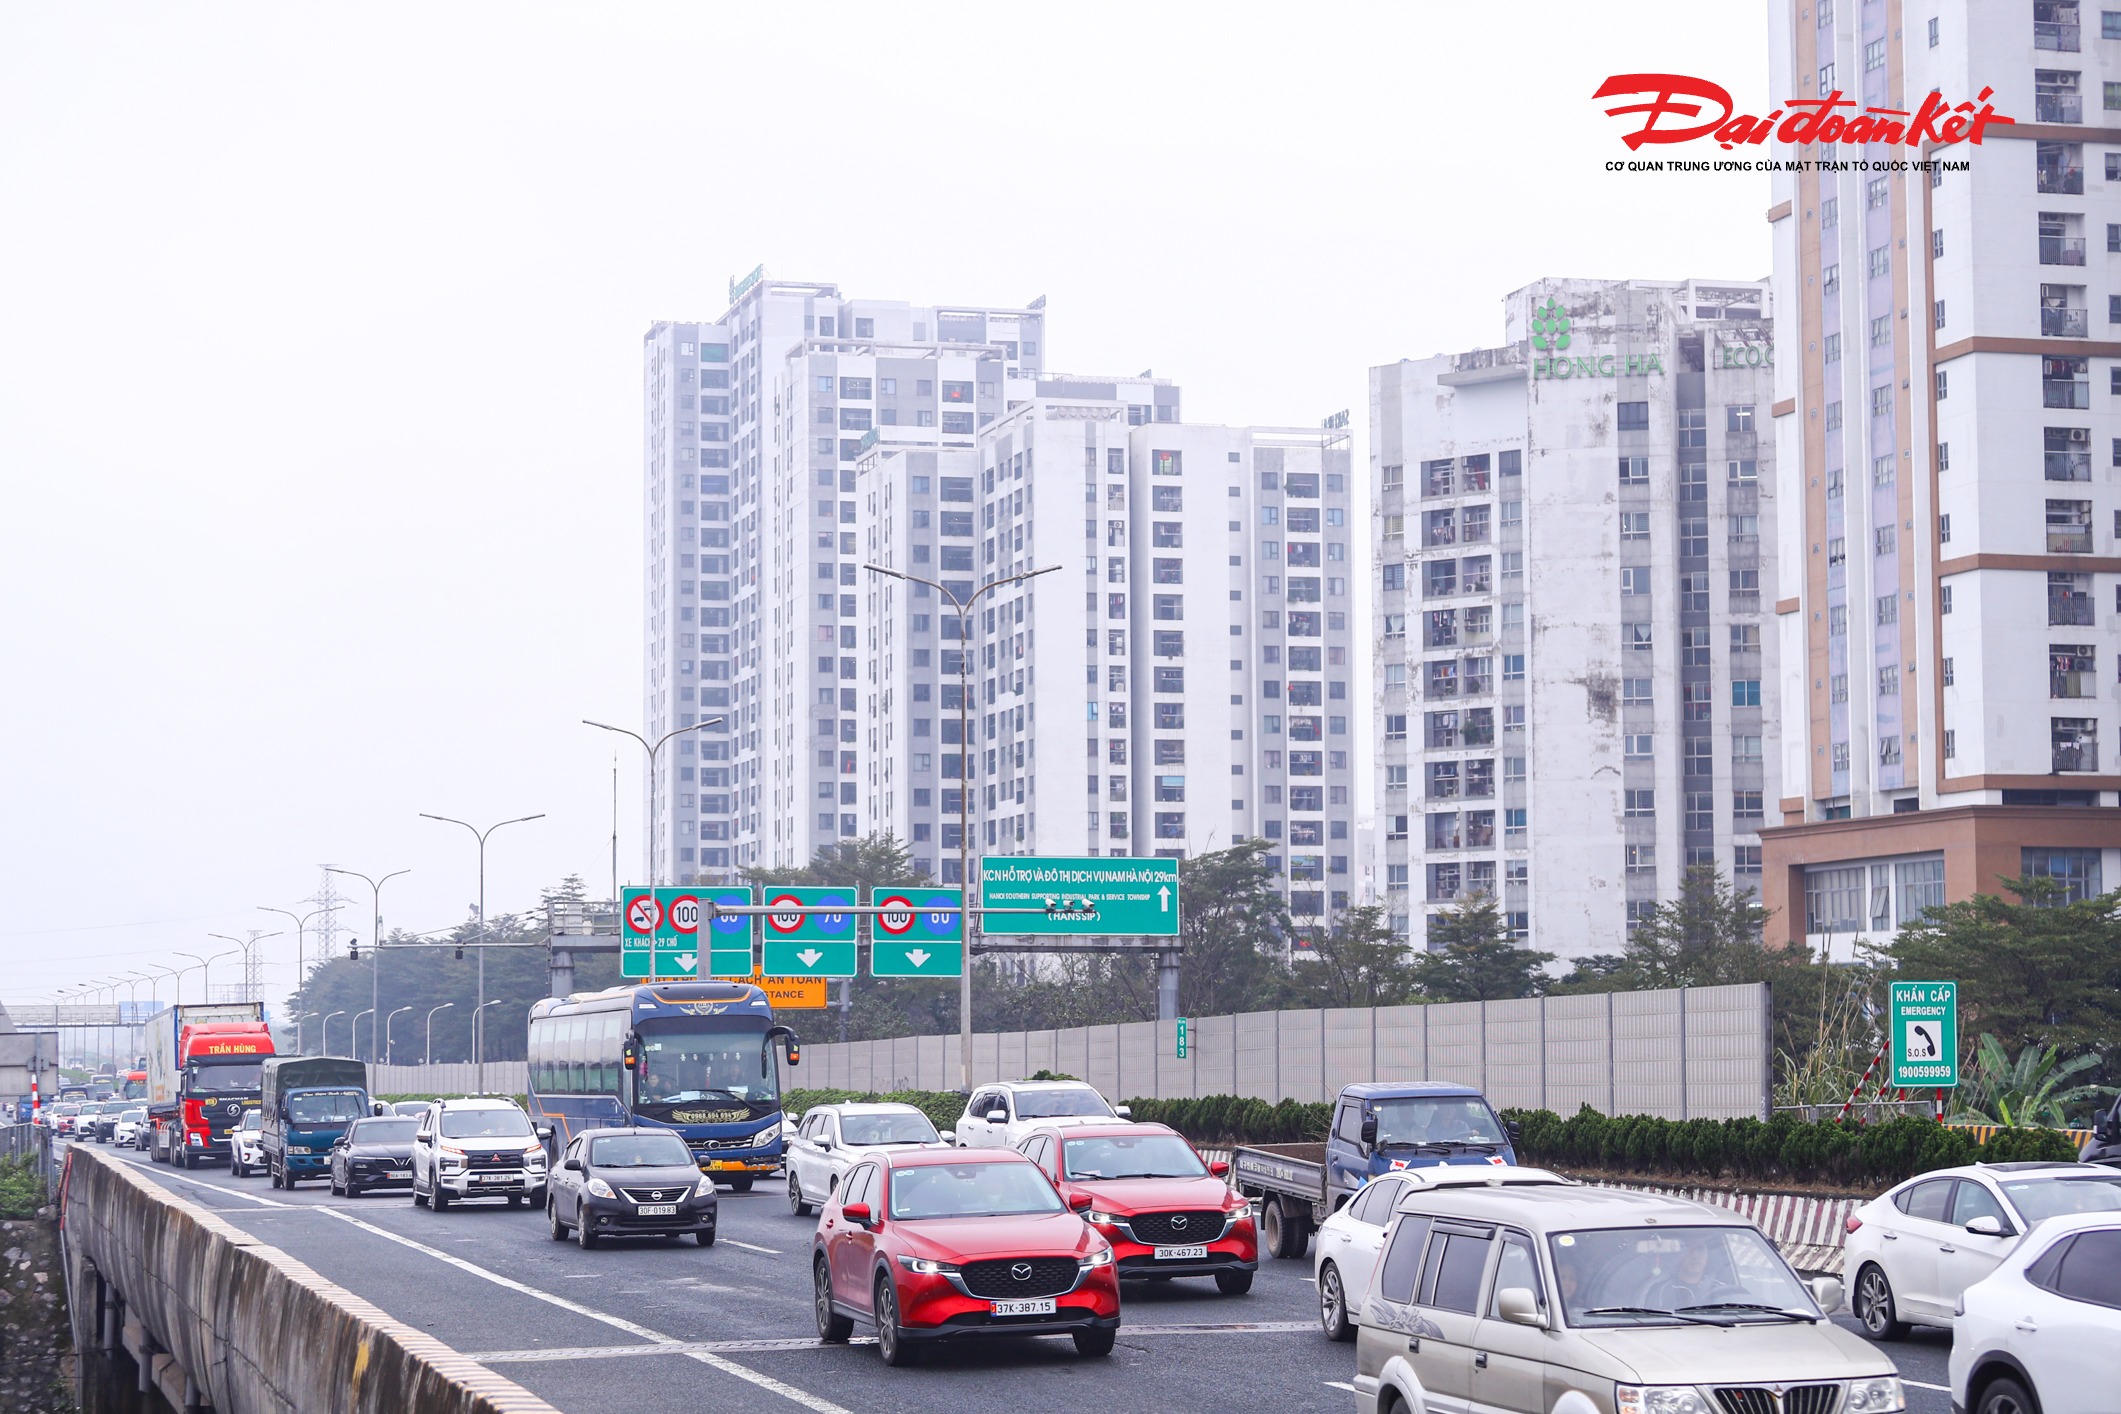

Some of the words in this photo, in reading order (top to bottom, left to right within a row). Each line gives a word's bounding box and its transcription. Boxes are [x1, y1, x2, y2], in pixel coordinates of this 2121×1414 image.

[983, 869, 1001, 882] KCN
[1016, 869, 1032, 884] TRỢ
[1033, 867, 1045, 882] VÀ
[1044, 868, 1058, 882] ĐÔ
[1059, 870, 1071, 884] THỊ
[1071, 870, 1092, 884] DỊCH
[1105, 870, 1125, 882] NAM
[1126, 867, 1138, 882] HÀ
[1138, 868, 1153, 884] NỘI
[676, 906, 698, 923] 100
[624, 937, 633, 947] XE
[1896, 985, 1925, 1002] KHẨN
[1930, 985, 1951, 1002] CẤP
[1901, 1006, 1946, 1016] EMERGENCY
[1898, 1065, 1951, 1078] 1900599959
[1159, 1247, 1203, 1258] 30K-467.23
[997, 1302, 1050, 1314] 37K-387.15
